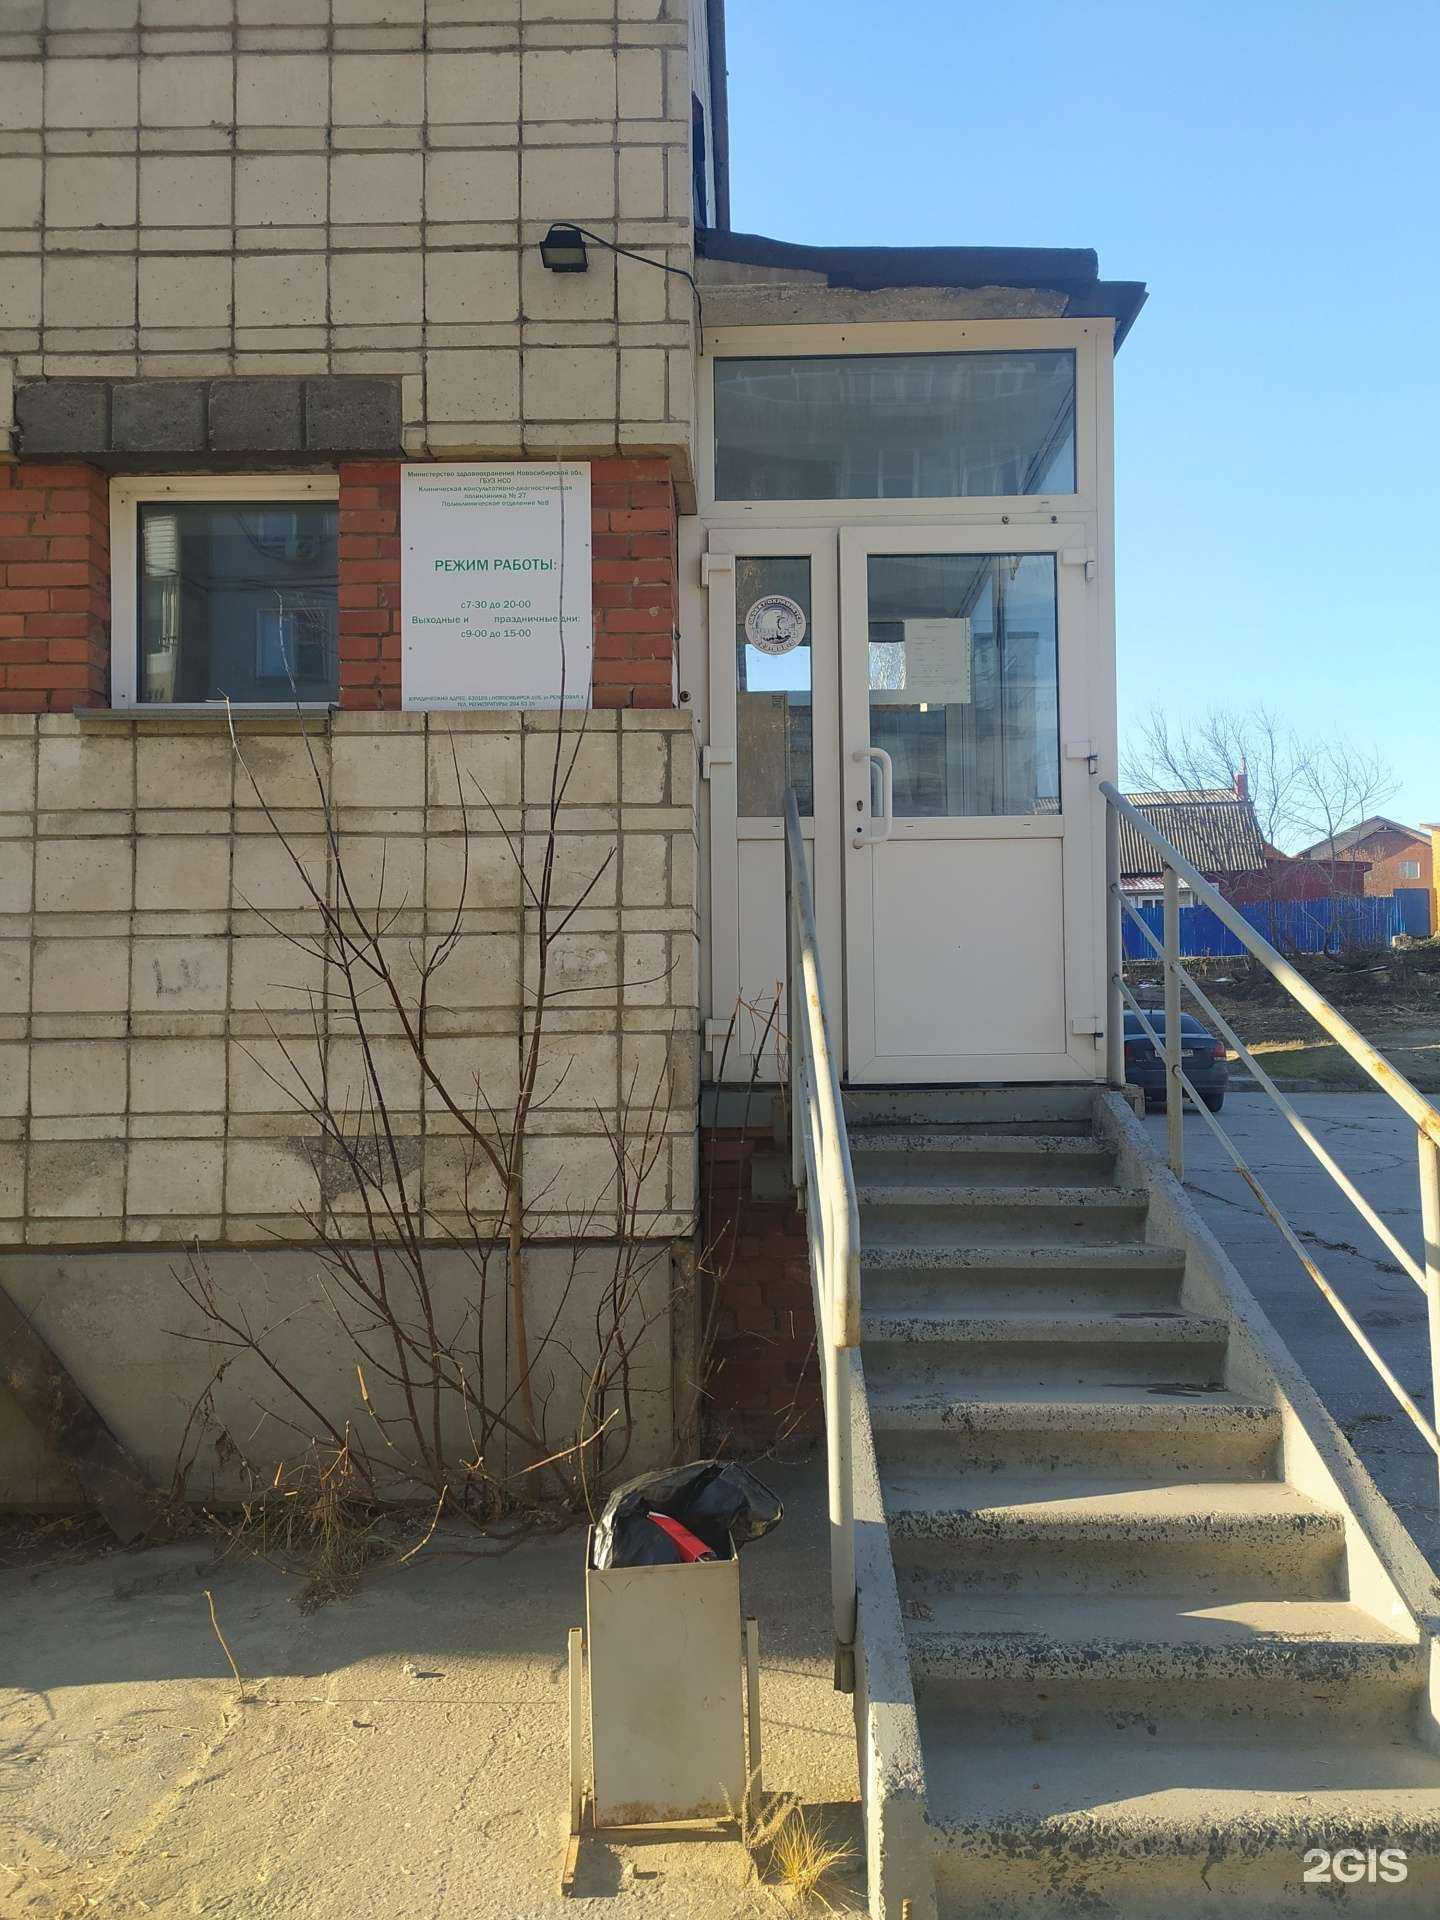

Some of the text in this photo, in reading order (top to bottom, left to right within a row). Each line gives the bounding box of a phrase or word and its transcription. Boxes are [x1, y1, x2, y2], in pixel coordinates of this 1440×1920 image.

[516, 469, 569, 477] Новосибирской
[434, 558, 558, 571] РЕЖИМ РАБОТЫ:
[489, 601, 501, 610] до
[503, 600, 532, 609] 20-00
[411, 616, 461, 625] Выходные
[463, 616, 469, 624] и
[494, 615, 558, 625] праздничные
[489, 630, 501, 639] до
[503, 629, 532, 638] 15-00
